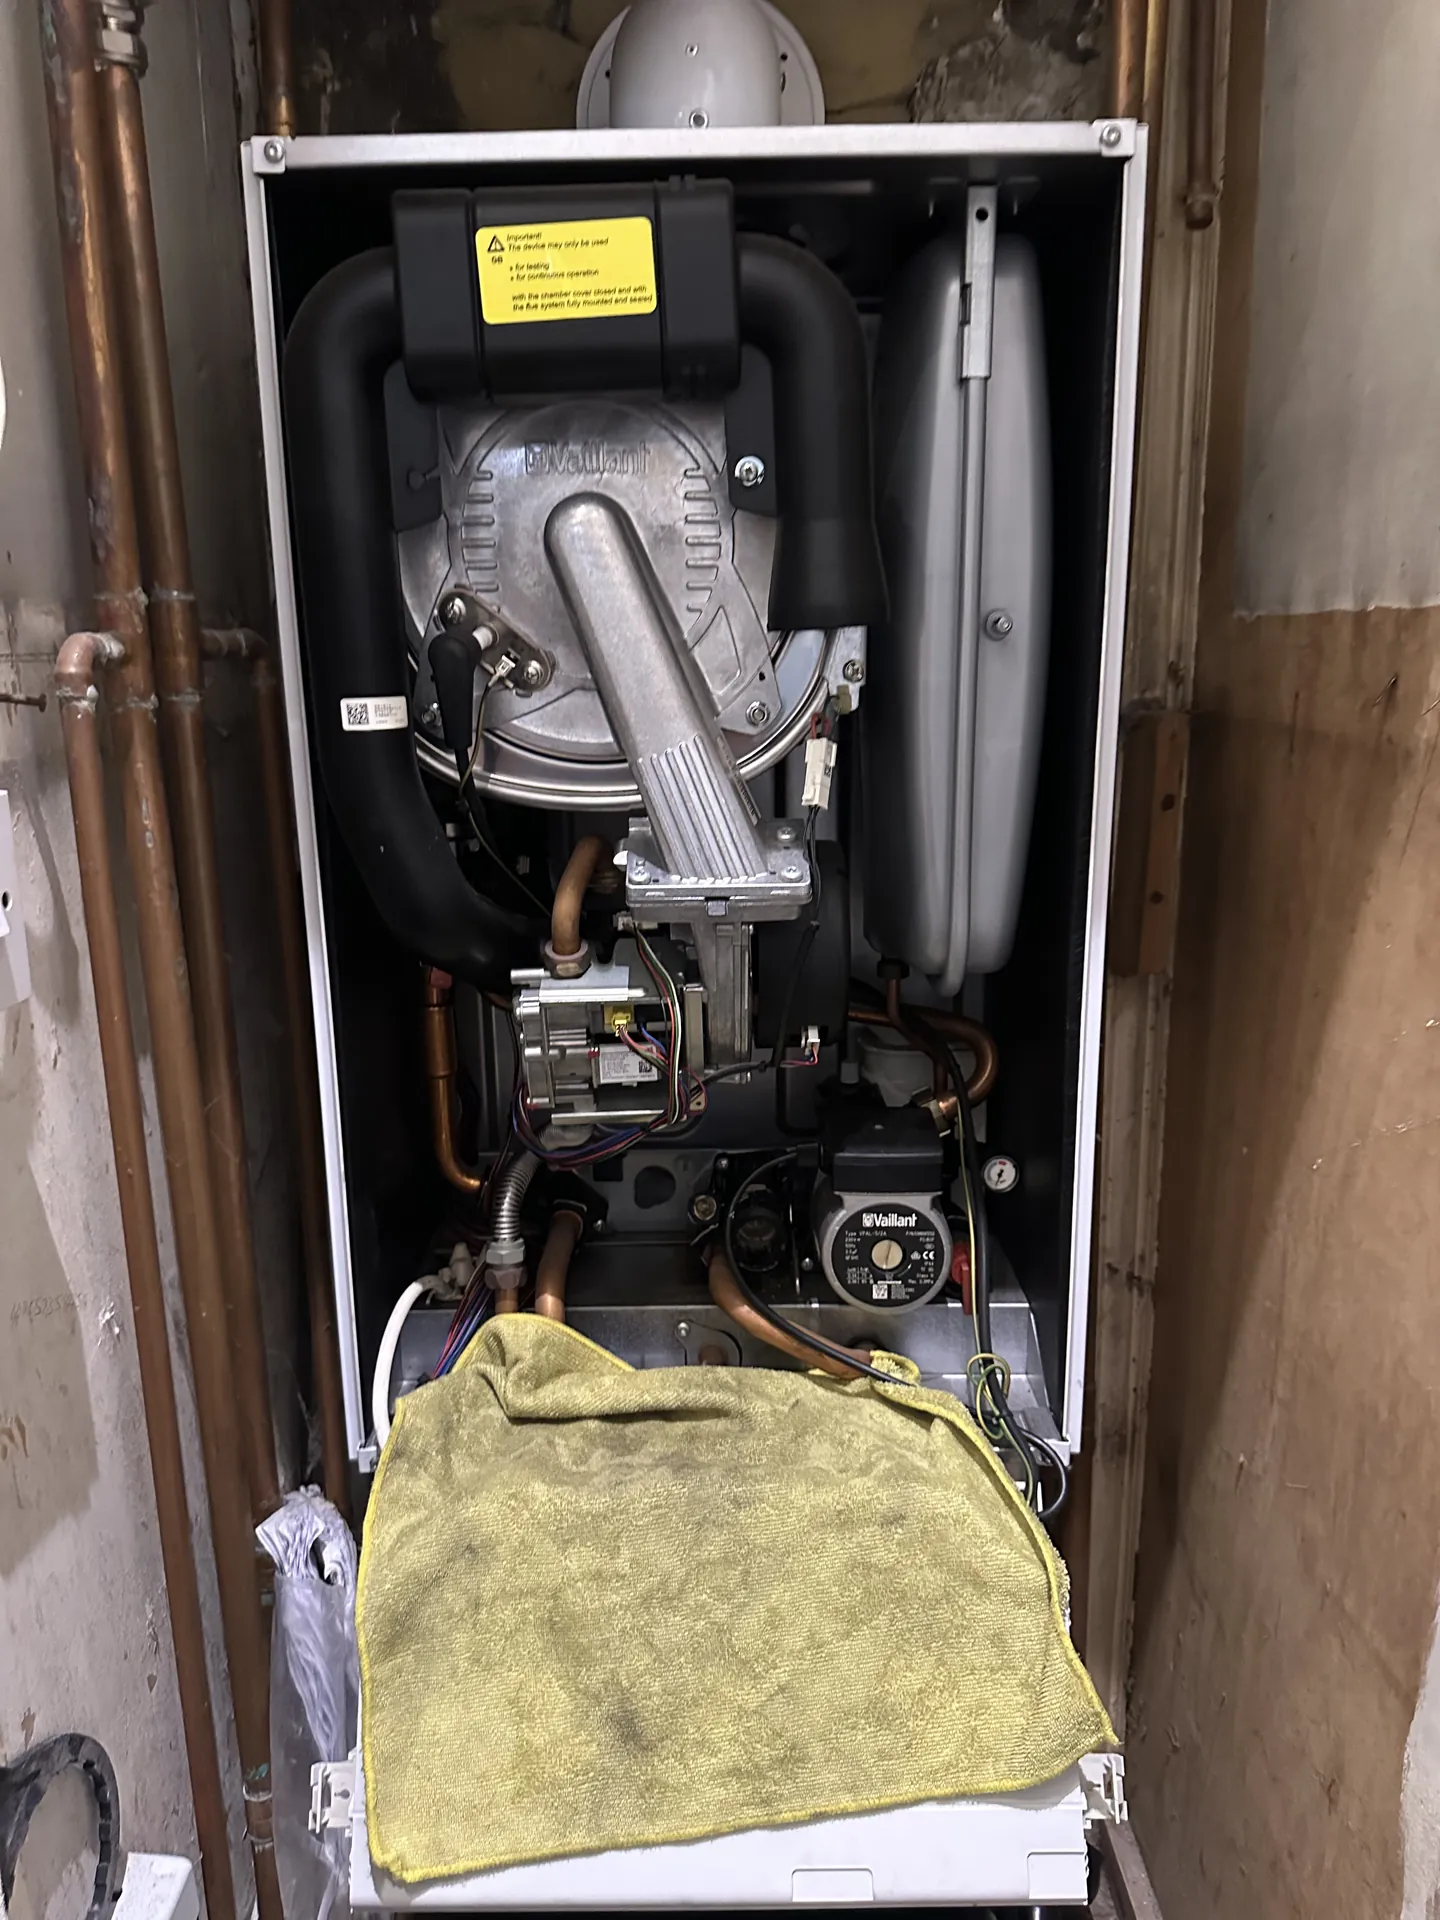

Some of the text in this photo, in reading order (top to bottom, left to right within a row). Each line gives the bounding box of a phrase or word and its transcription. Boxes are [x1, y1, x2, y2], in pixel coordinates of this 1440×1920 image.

[506, 232, 542, 242] Important!
[508, 237, 609, 252] The device may only be used
[491, 256, 503, 264] GB
[515, 261, 550, 271] for testing
[516, 268, 600, 281] for continuous operation
[512, 285, 647, 301] with the chamber cover closed and with
[513, 294, 653, 311] the flue system fully mounted and sealed
[550, 441, 650, 475] Vaillant
[874, 1213, 917, 1227] Vaillant
